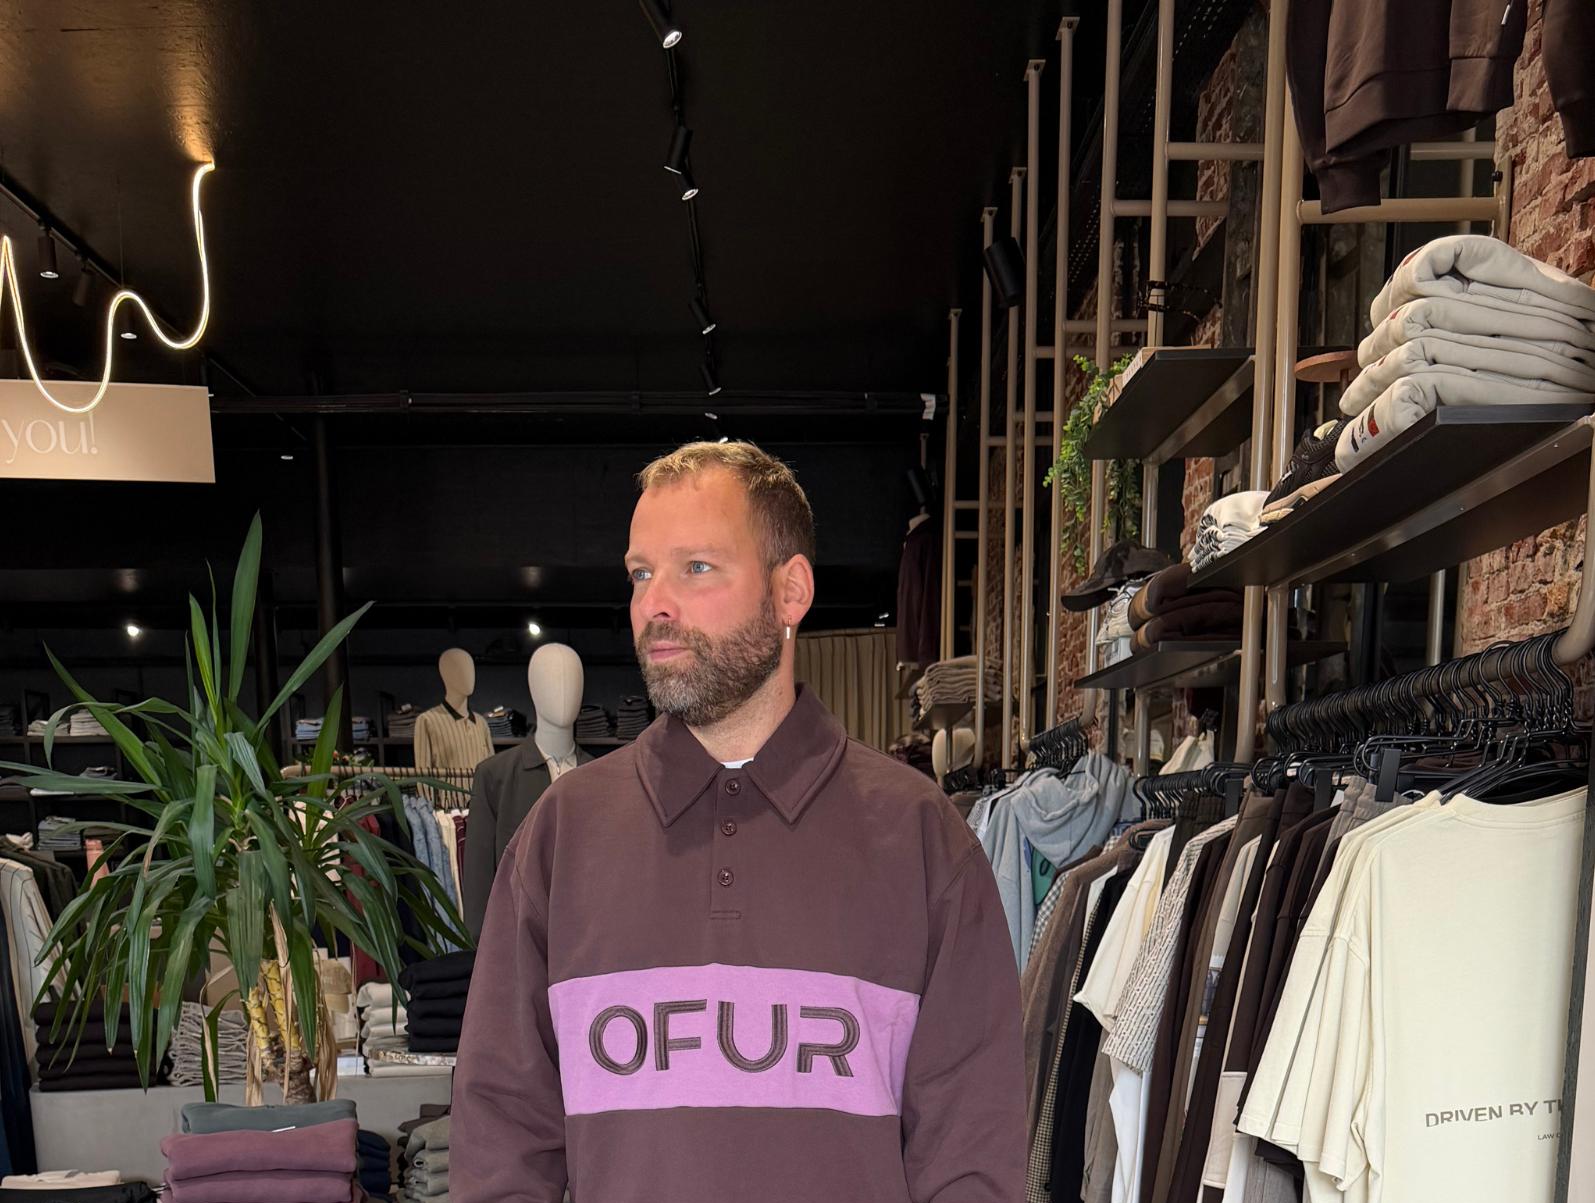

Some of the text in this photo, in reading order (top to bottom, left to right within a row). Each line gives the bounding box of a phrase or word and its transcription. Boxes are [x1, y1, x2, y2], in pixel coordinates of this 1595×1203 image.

[1, 413, 98, 464] you!
[589, 999, 861, 1078] OFUR
[1425, 1105, 1503, 1127] DRIVEN
